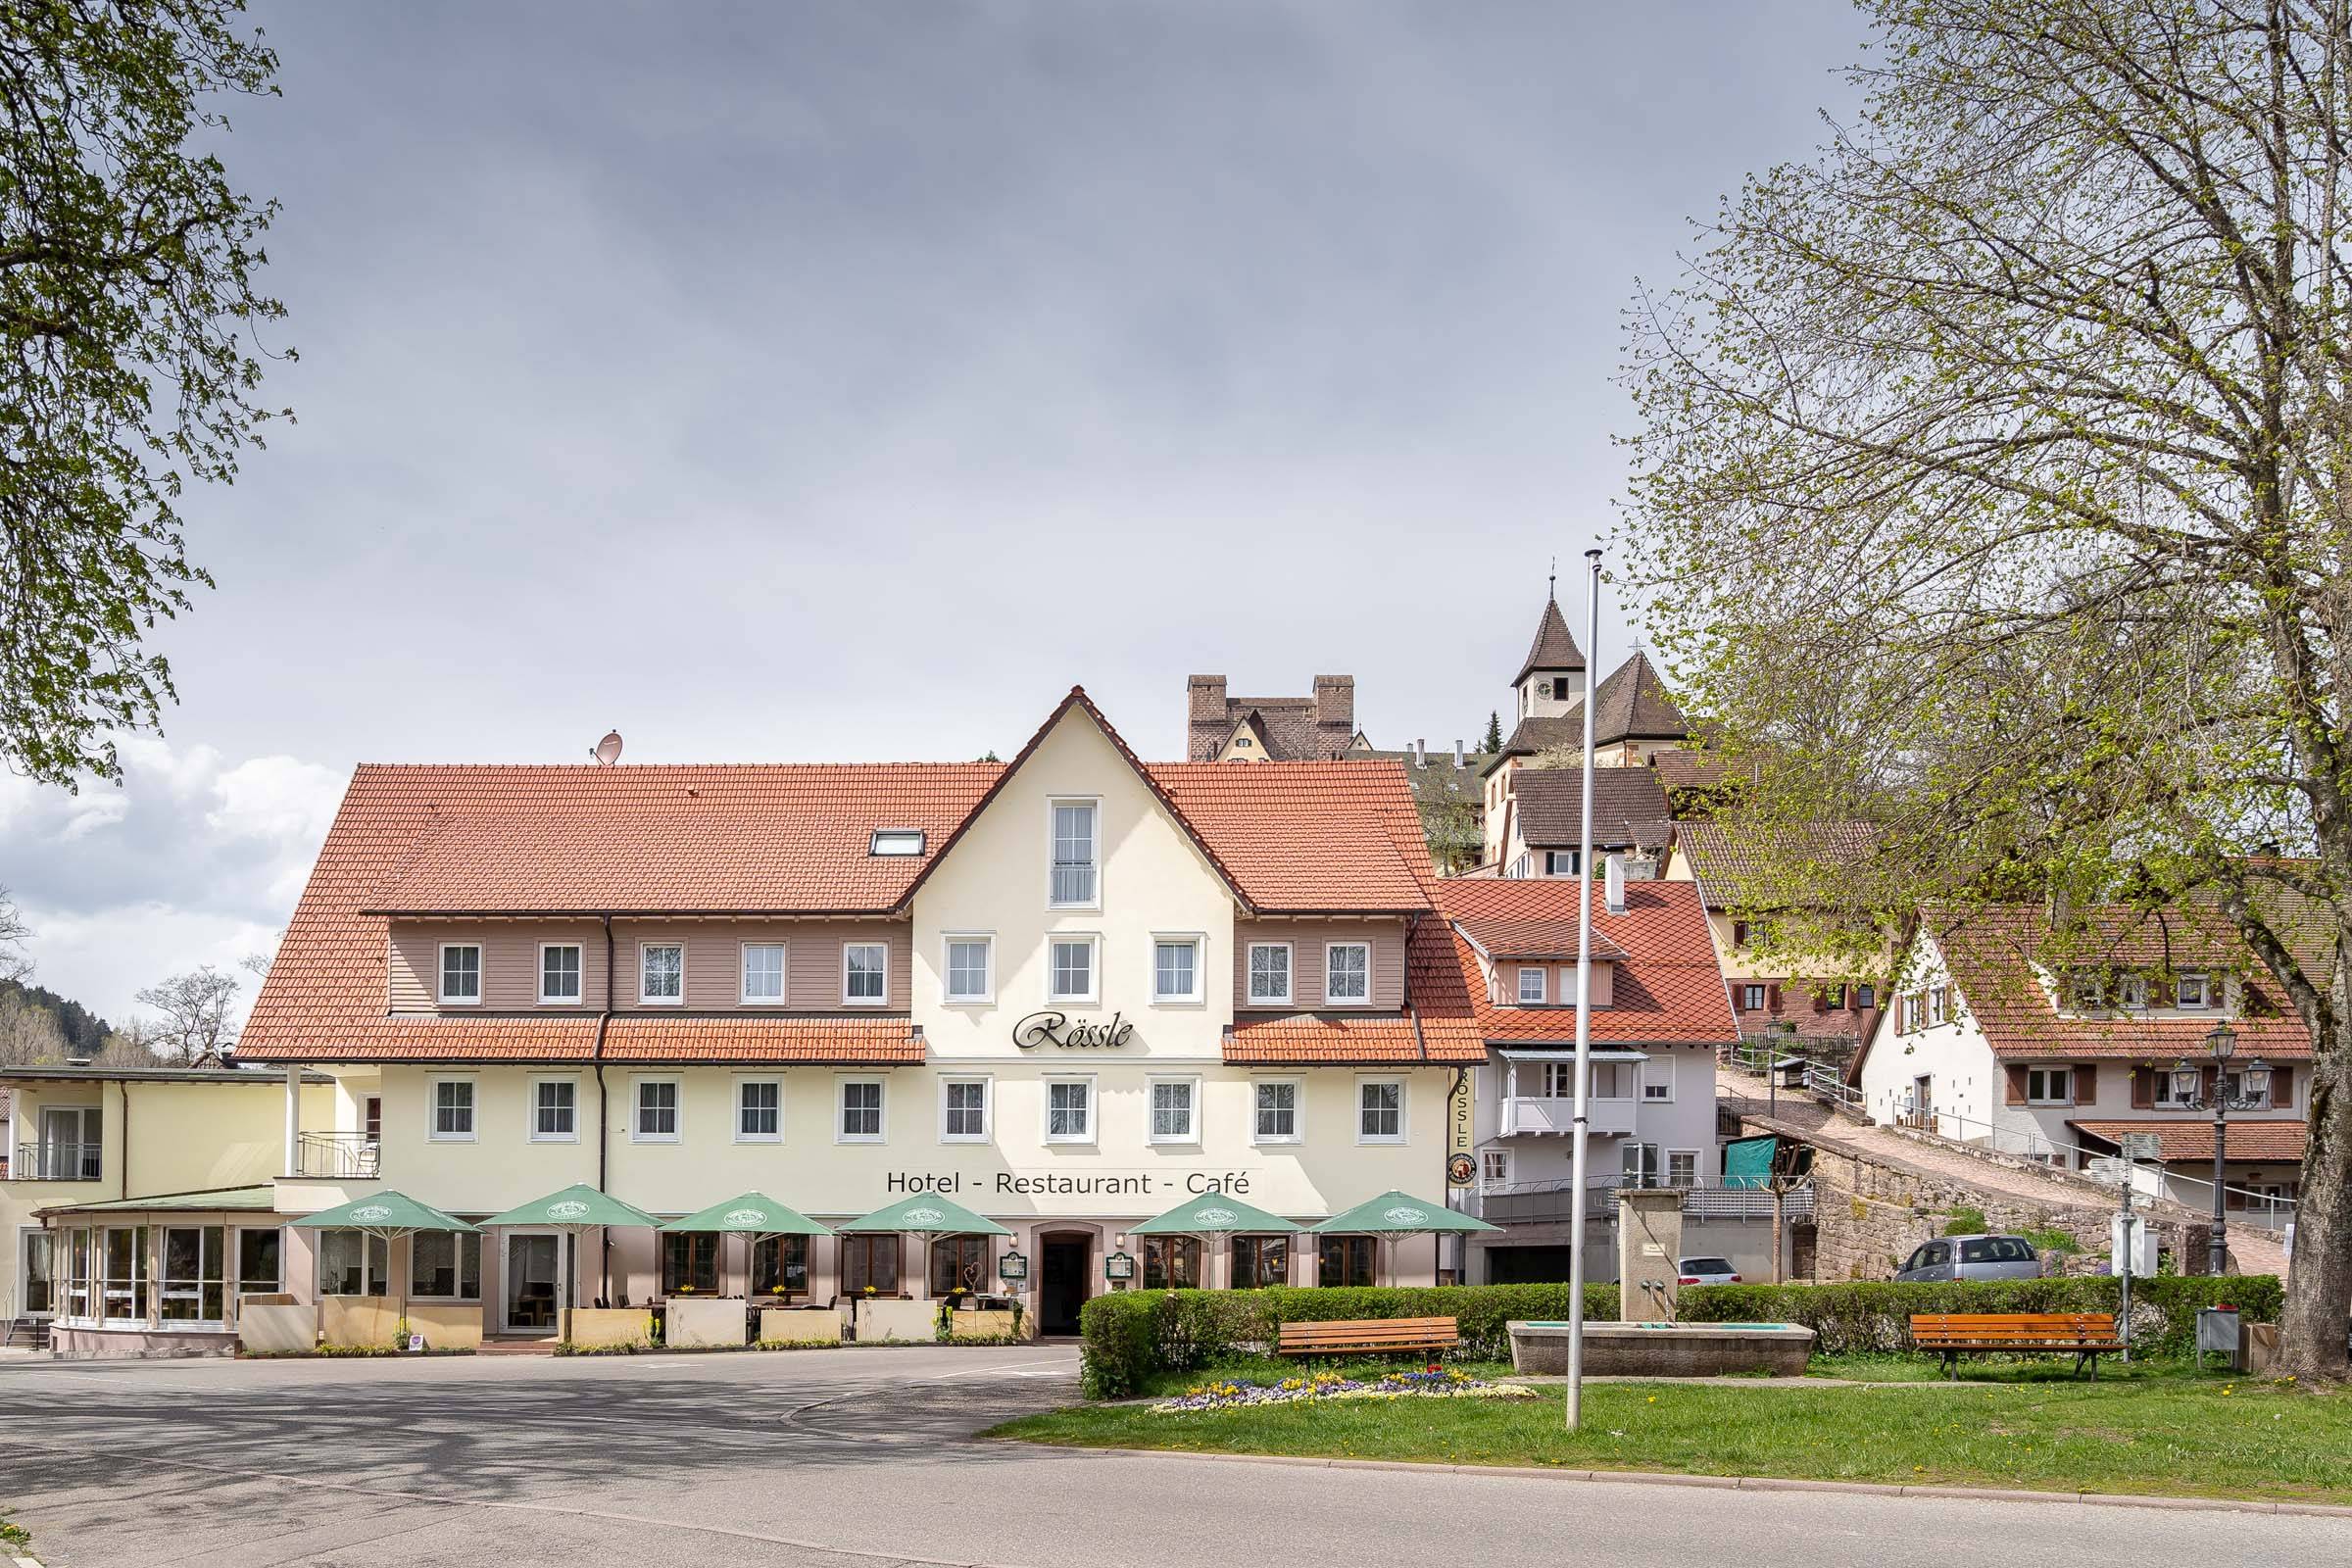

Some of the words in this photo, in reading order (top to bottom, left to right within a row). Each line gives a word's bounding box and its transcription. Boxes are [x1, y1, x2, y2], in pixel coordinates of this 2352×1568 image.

[1012, 1010, 1134, 1049] Rössle
[887, 1171, 959, 1194] Hotel
[996, 1173, 1152, 1195] Restaurant
[1186, 1171, 1250, 1195] Café
